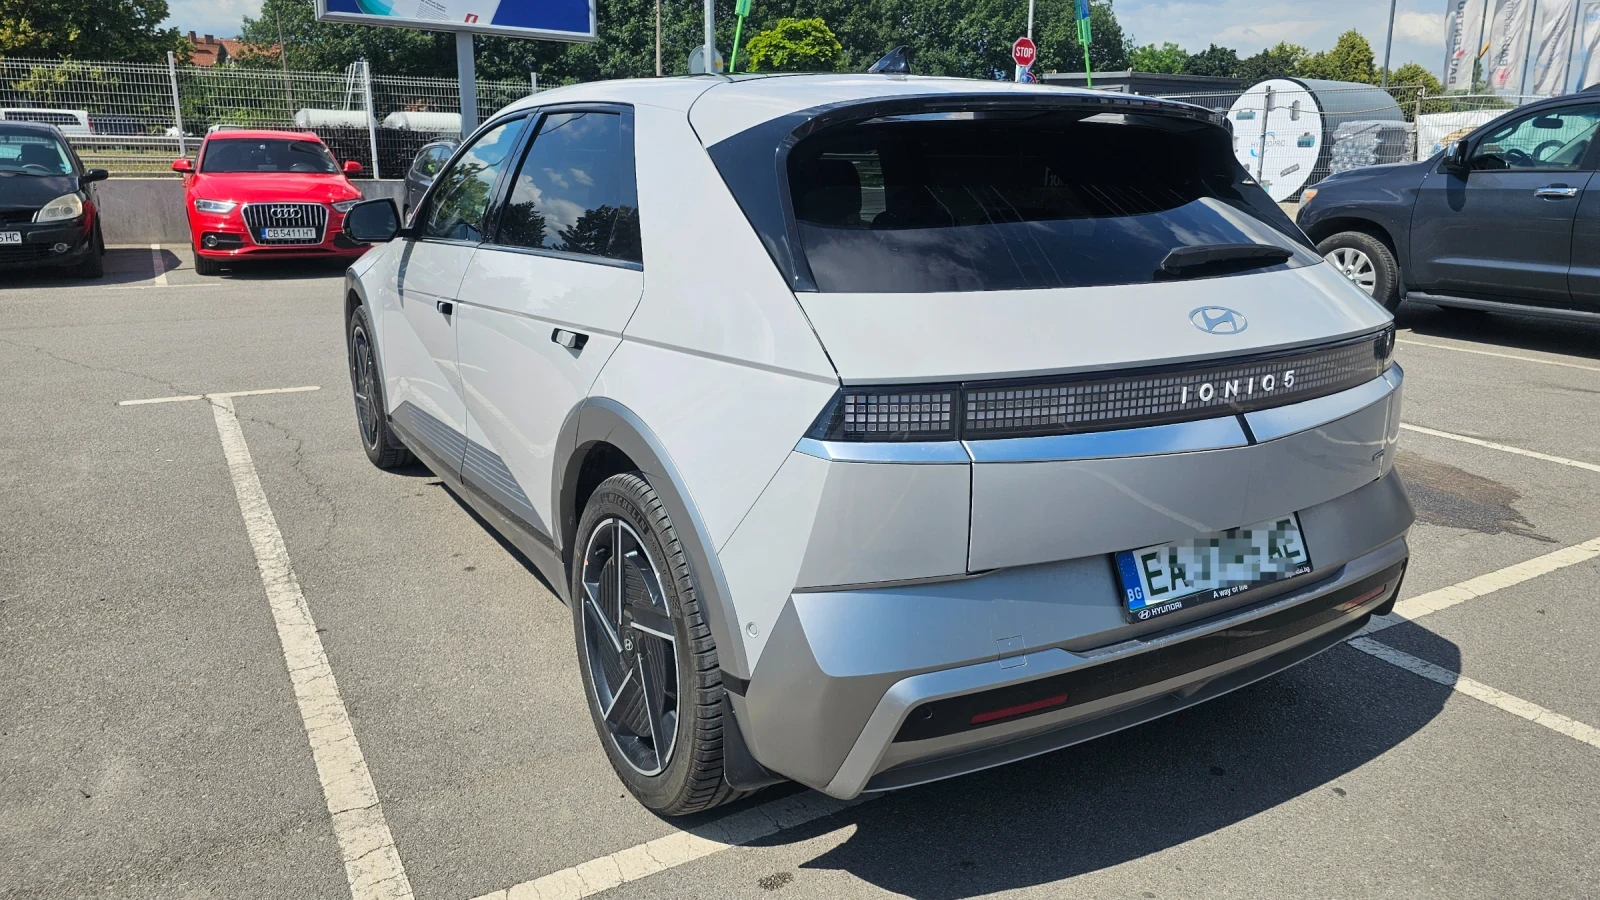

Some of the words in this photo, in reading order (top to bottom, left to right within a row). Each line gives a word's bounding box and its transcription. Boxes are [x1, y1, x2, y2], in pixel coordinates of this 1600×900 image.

[1015, 46, 1034, 58] STOP
[1250, 139, 1286, 148] HYROPRO
[1127, 587, 1143, 602] BG
[1151, 601, 1183, 616] HYUNDAI
[1219, 589, 1231, 598] way
